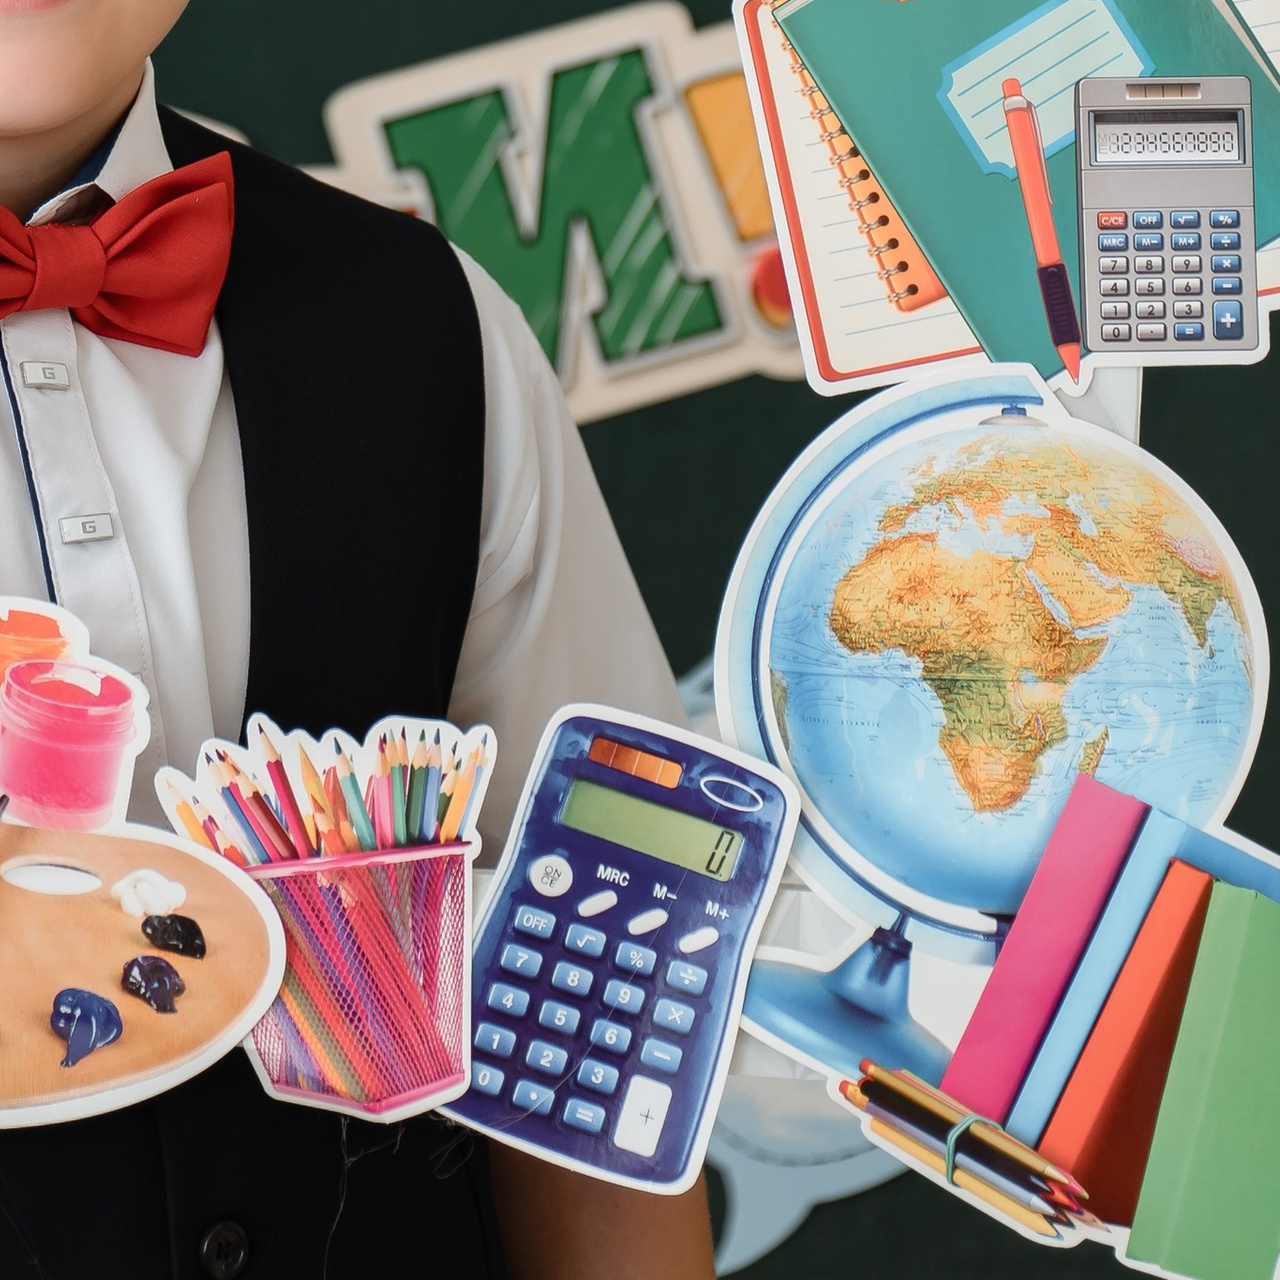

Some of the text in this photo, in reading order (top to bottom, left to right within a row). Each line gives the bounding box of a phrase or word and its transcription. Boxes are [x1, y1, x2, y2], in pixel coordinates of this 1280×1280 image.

[1101, 216, 1123, 225] C/CE
[1140, 216, 1157, 224] OFF
[1103, 238, 1124, 246] MRC
[1111, 260, 1117, 271] 7
[1146, 260, 1153, 270] 8
[1184, 259, 1190, 270] 9
[1111, 283, 1118, 293] 4
[1147, 282, 1154, 292] 5
[1184, 282, 1191, 292] 6
[1113, 305, 1117, 316] 1
[1148, 305, 1155, 315] 2
[1185, 304, 1192, 315] 3
[1113, 327, 1120, 338] 0
[42, 367, 56, 380] G
[81, 520, 97, 534] G
[544, 865, 562, 878] ON
[597, 864, 630, 887] MRC
[541, 876, 556, 888] CE
[705, 901, 730, 920] M+
[523, 914, 548, 931] OFF
[516, 952, 528, 969] 7
[568, 971, 580, 987] 8
[502, 993, 514, 1009] 4
[618, 987, 631, 1004] 9
[554, 1010, 567, 1026] 5
[492, 1033, 501, 1050] 1
[605, 1028, 618, 1044] 6
[540, 1050, 554, 1067] 2
[478, 1069, 490, 1086] 0
[591, 1068, 605, 1084] 3
